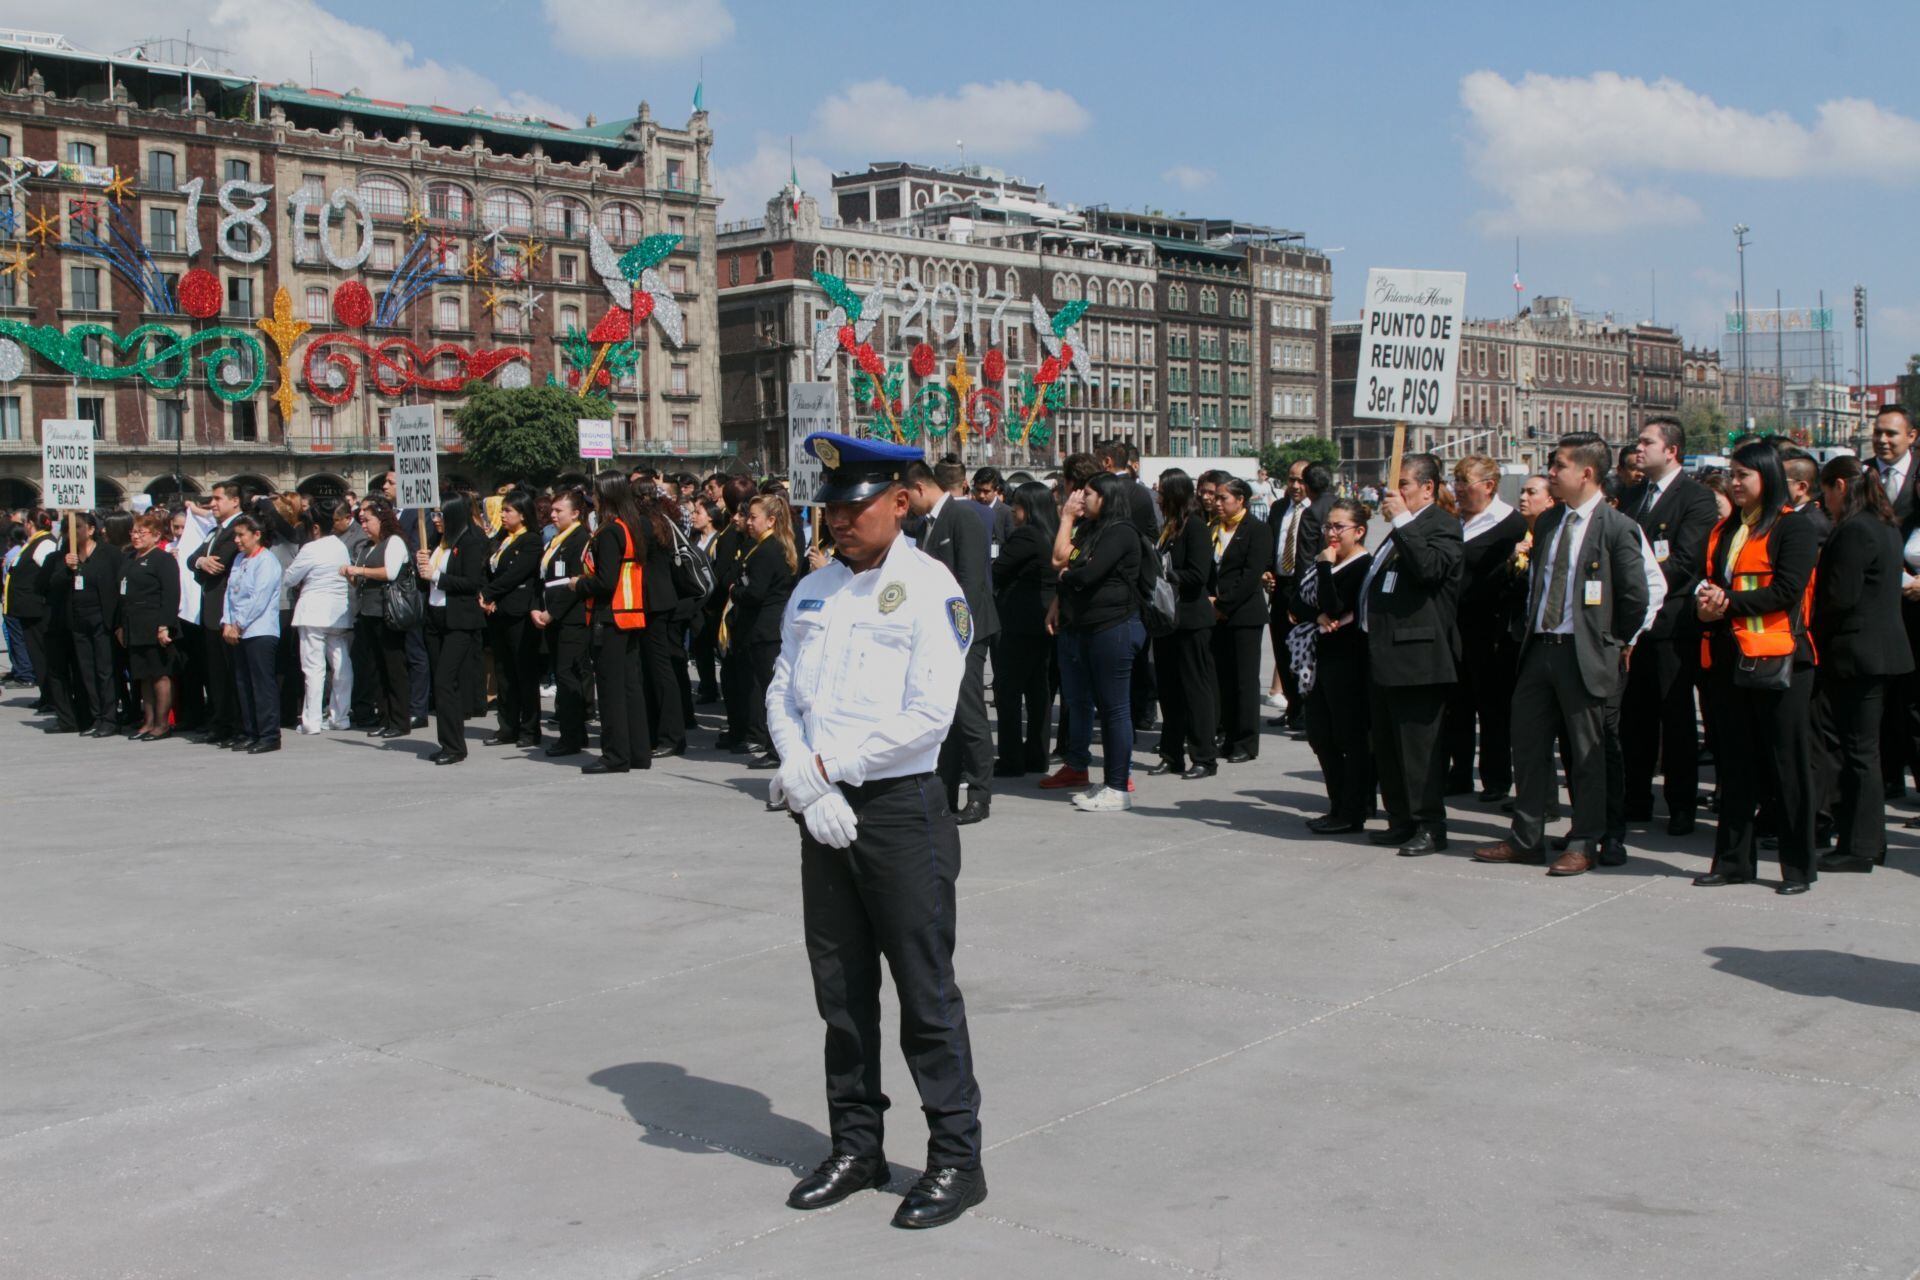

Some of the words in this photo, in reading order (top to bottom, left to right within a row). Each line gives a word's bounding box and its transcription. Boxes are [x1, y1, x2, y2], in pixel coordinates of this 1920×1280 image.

[178, 176, 374, 270] 1810
[896, 276, 1015, 346] 2017
[1370, 312, 1426, 338] PUNTO
[1430, 315, 1452, 340] DE
[1371, 344, 1445, 372] REUNION
[1368, 376, 1396, 413] 3er.
[1401, 378, 1440, 416] PISO
[47, 445, 75, 460] PUNTO
[78, 446, 89, 460] DE
[396, 435, 420, 453] PUNTO
[421, 434, 431, 452] DE
[49, 464, 88, 480] REUNION
[399, 457, 431, 475] REUNION
[52, 484, 85, 495] PLANTA
[58, 494, 80, 505] BAJA
[415, 478, 432, 504] PISO
